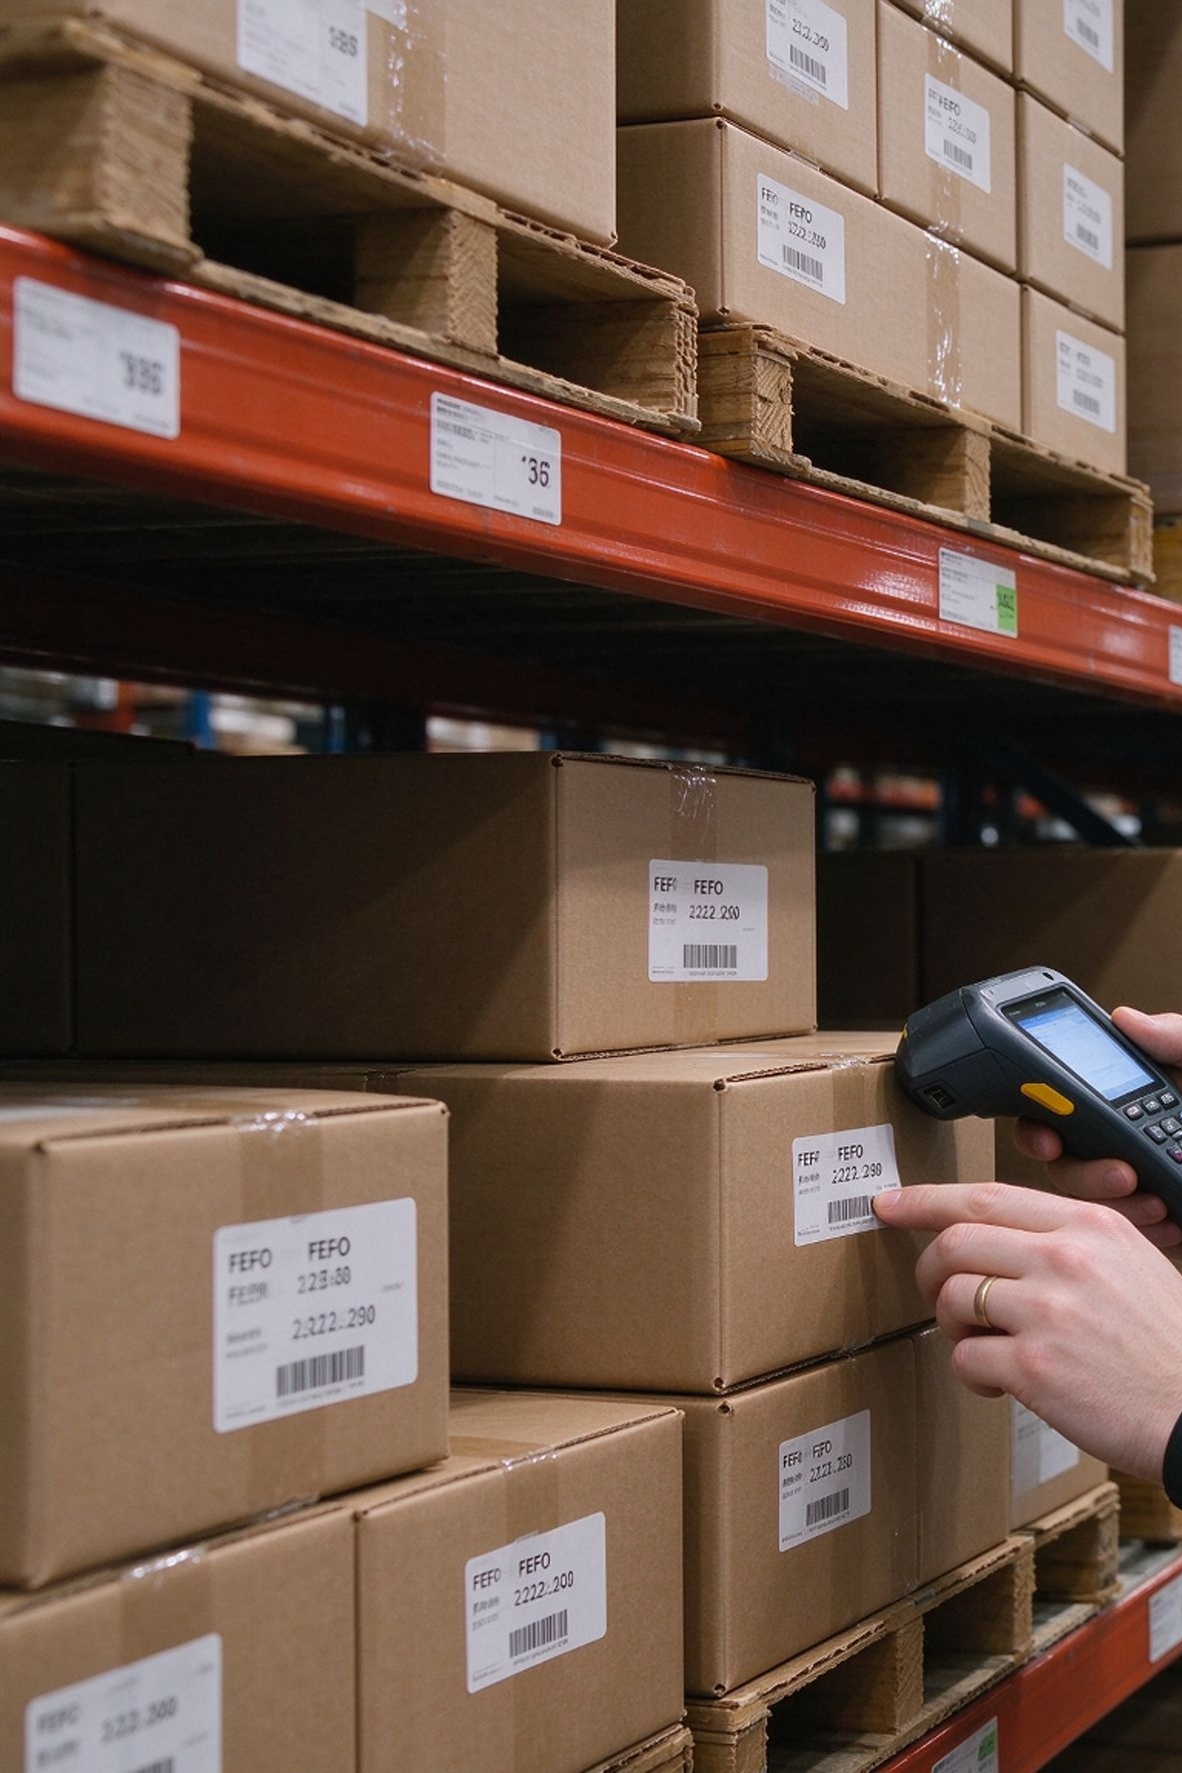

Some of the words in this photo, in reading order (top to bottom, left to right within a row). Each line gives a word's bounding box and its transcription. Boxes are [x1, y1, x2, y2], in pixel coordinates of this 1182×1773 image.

[694, 879, 724, 895] FEFO
[838, 1144, 864, 1161] FEFO
[229, 1248, 273, 1274] FEFO
[308, 1236, 351, 1262] FEFO
[518, 1551, 552, 1577] FEFO
